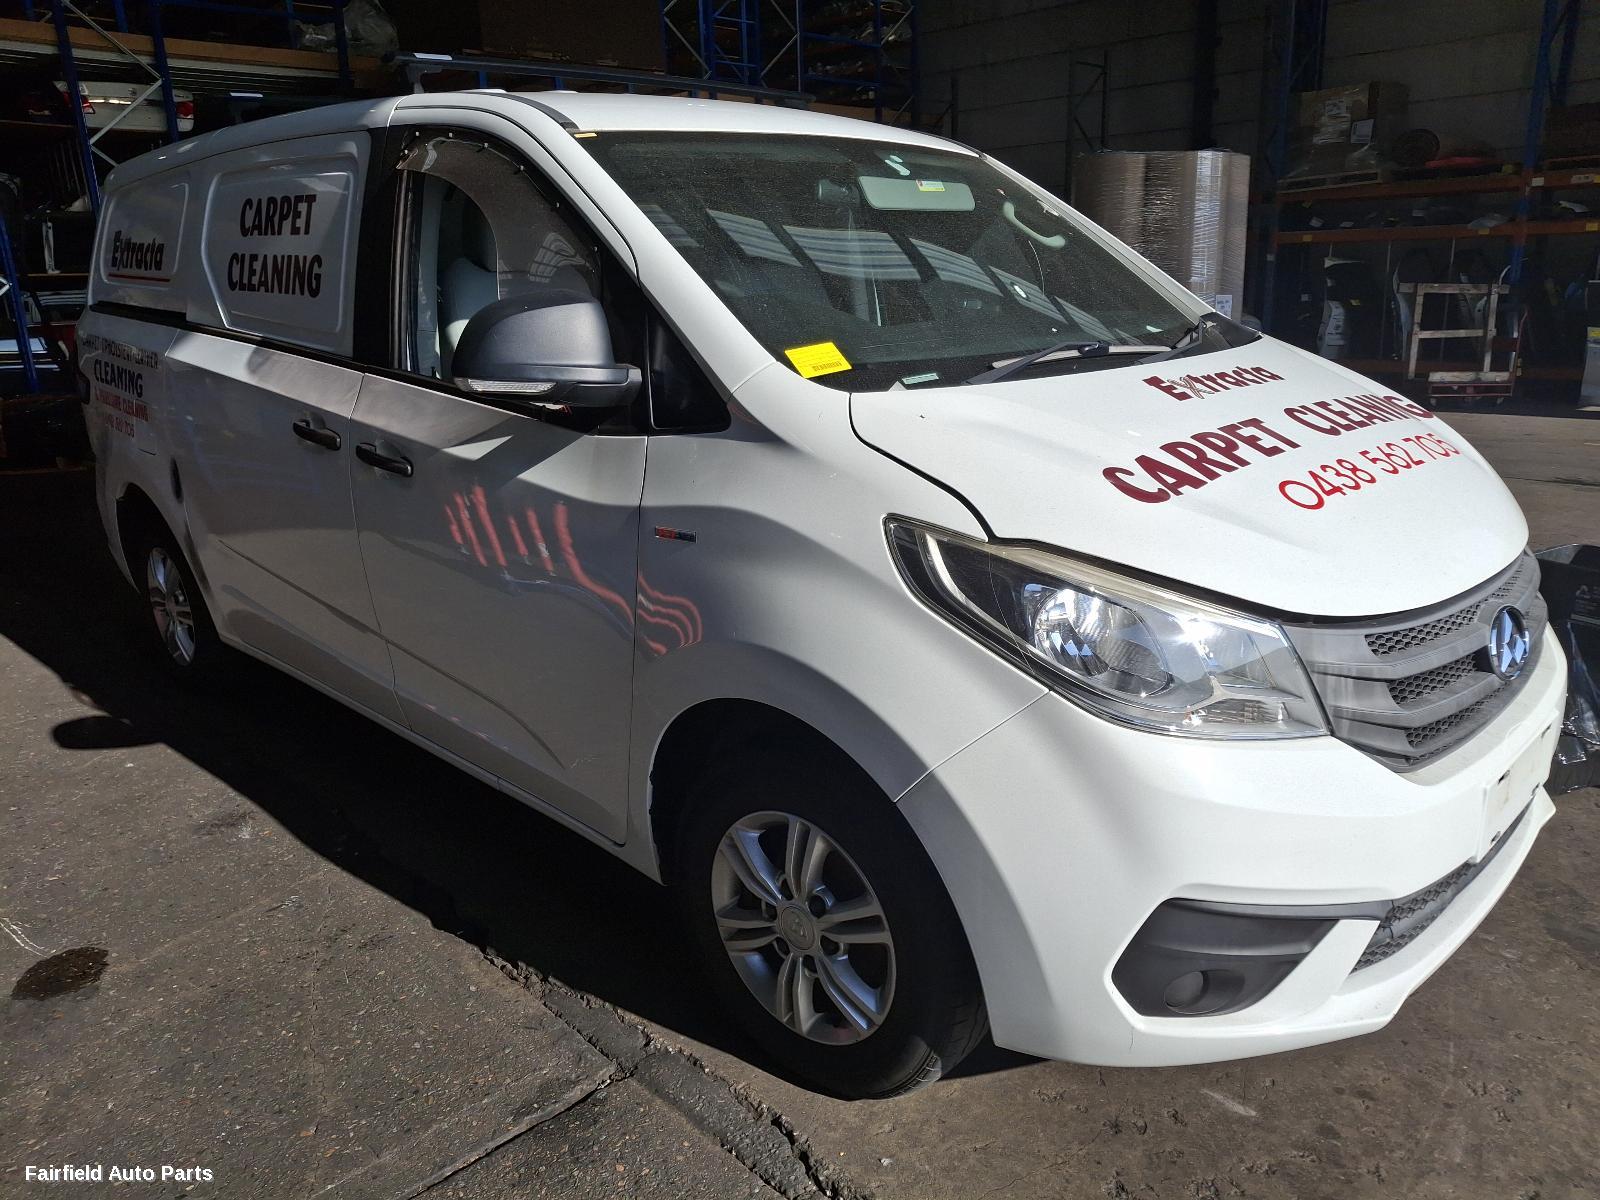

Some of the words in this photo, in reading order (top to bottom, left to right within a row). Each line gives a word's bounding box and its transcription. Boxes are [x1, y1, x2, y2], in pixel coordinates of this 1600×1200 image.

[240, 194, 317, 237] CARPET
[227, 252, 323, 298] CLEANING
[94, 359, 143, 398] CLEANING
[1103, 417, 1301, 503] CARPET
[1278, 459, 1377, 510] 0438
[1359, 442, 1425, 475] 562
[1404, 433, 1463, 461] 705
